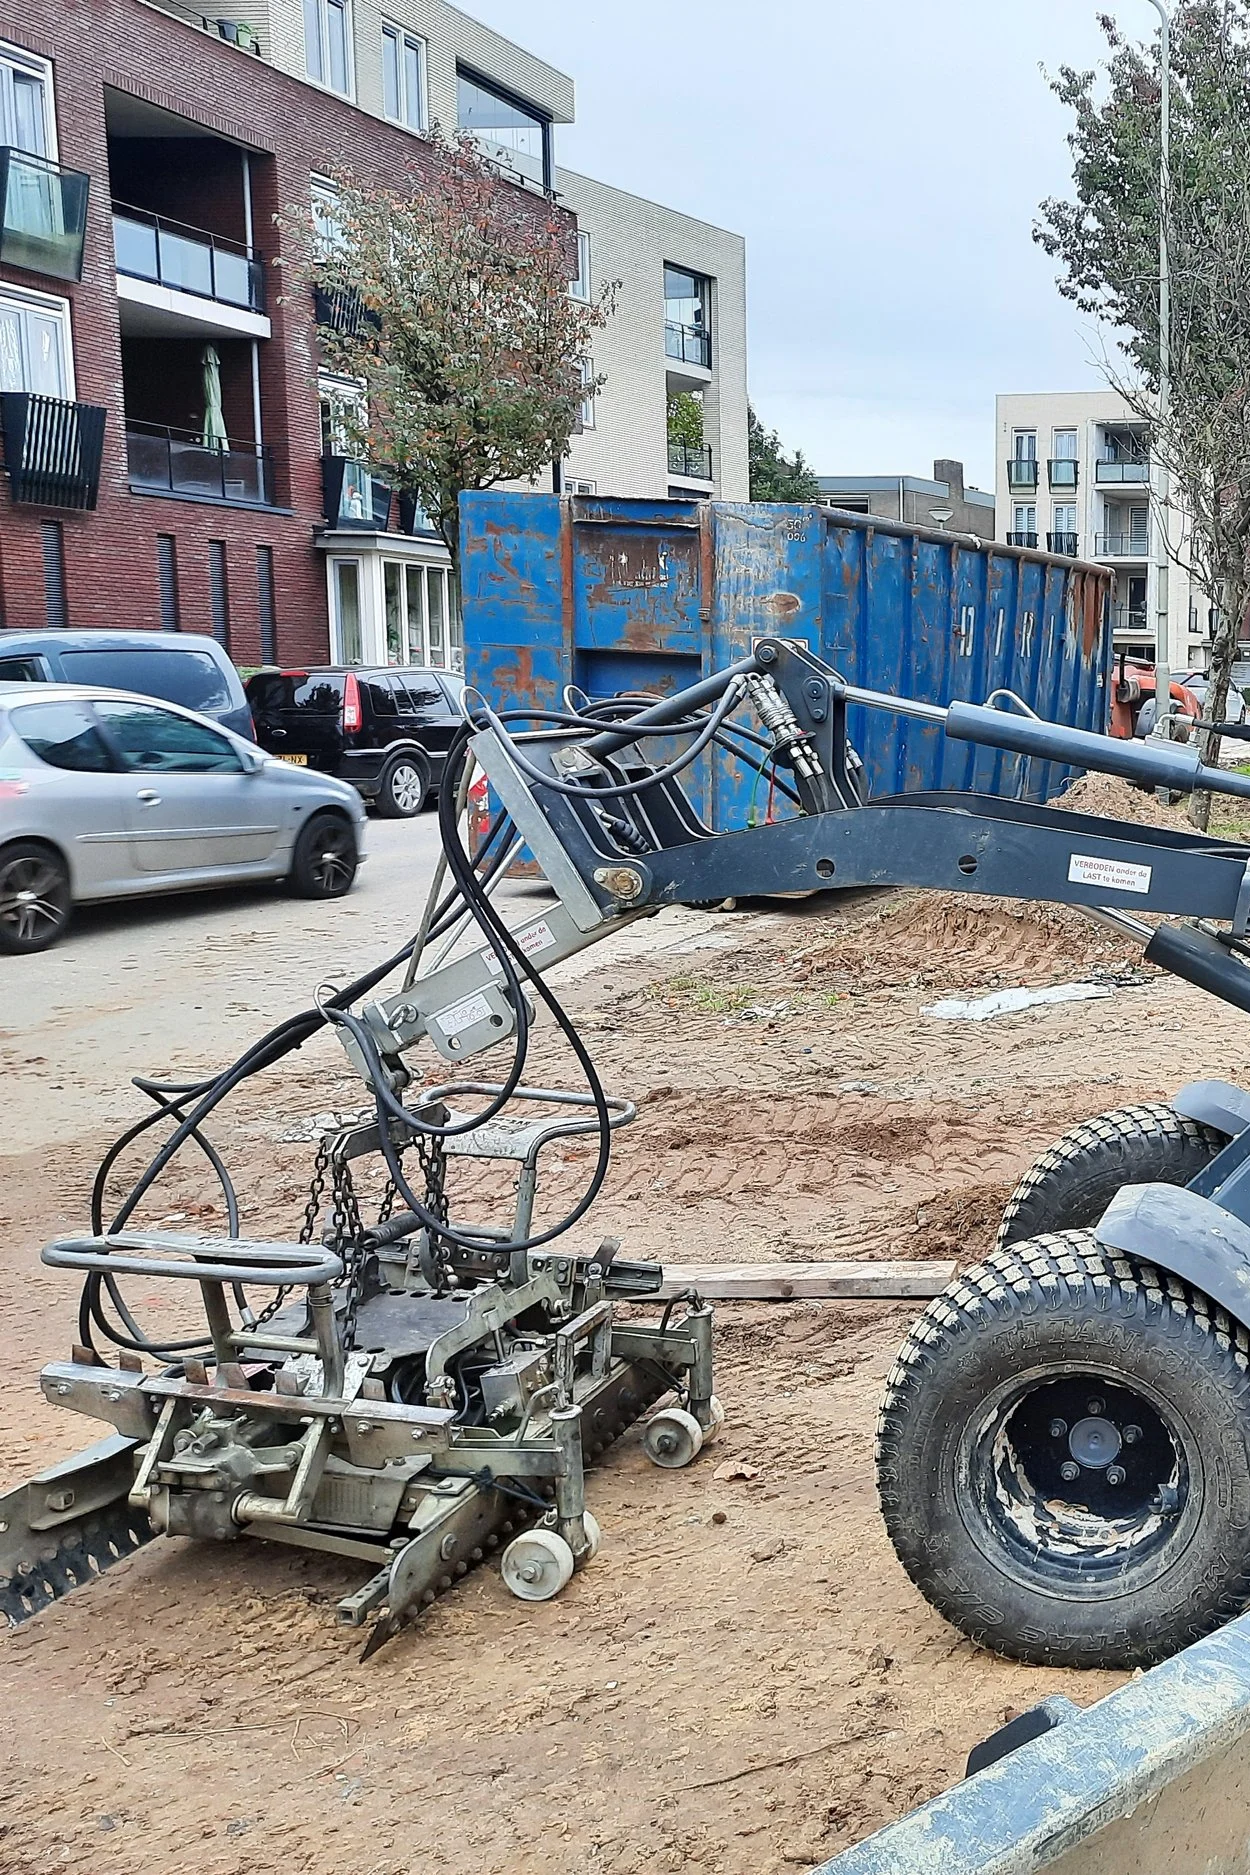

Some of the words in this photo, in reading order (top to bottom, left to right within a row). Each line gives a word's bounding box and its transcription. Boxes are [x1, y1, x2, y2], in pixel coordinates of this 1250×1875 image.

[1074, 860, 1115, 872] VERBODEN
[1115, 866, 1137, 876] onder
[1082, 871, 1102, 881] LAST
[1111, 875, 1136, 887] komen
